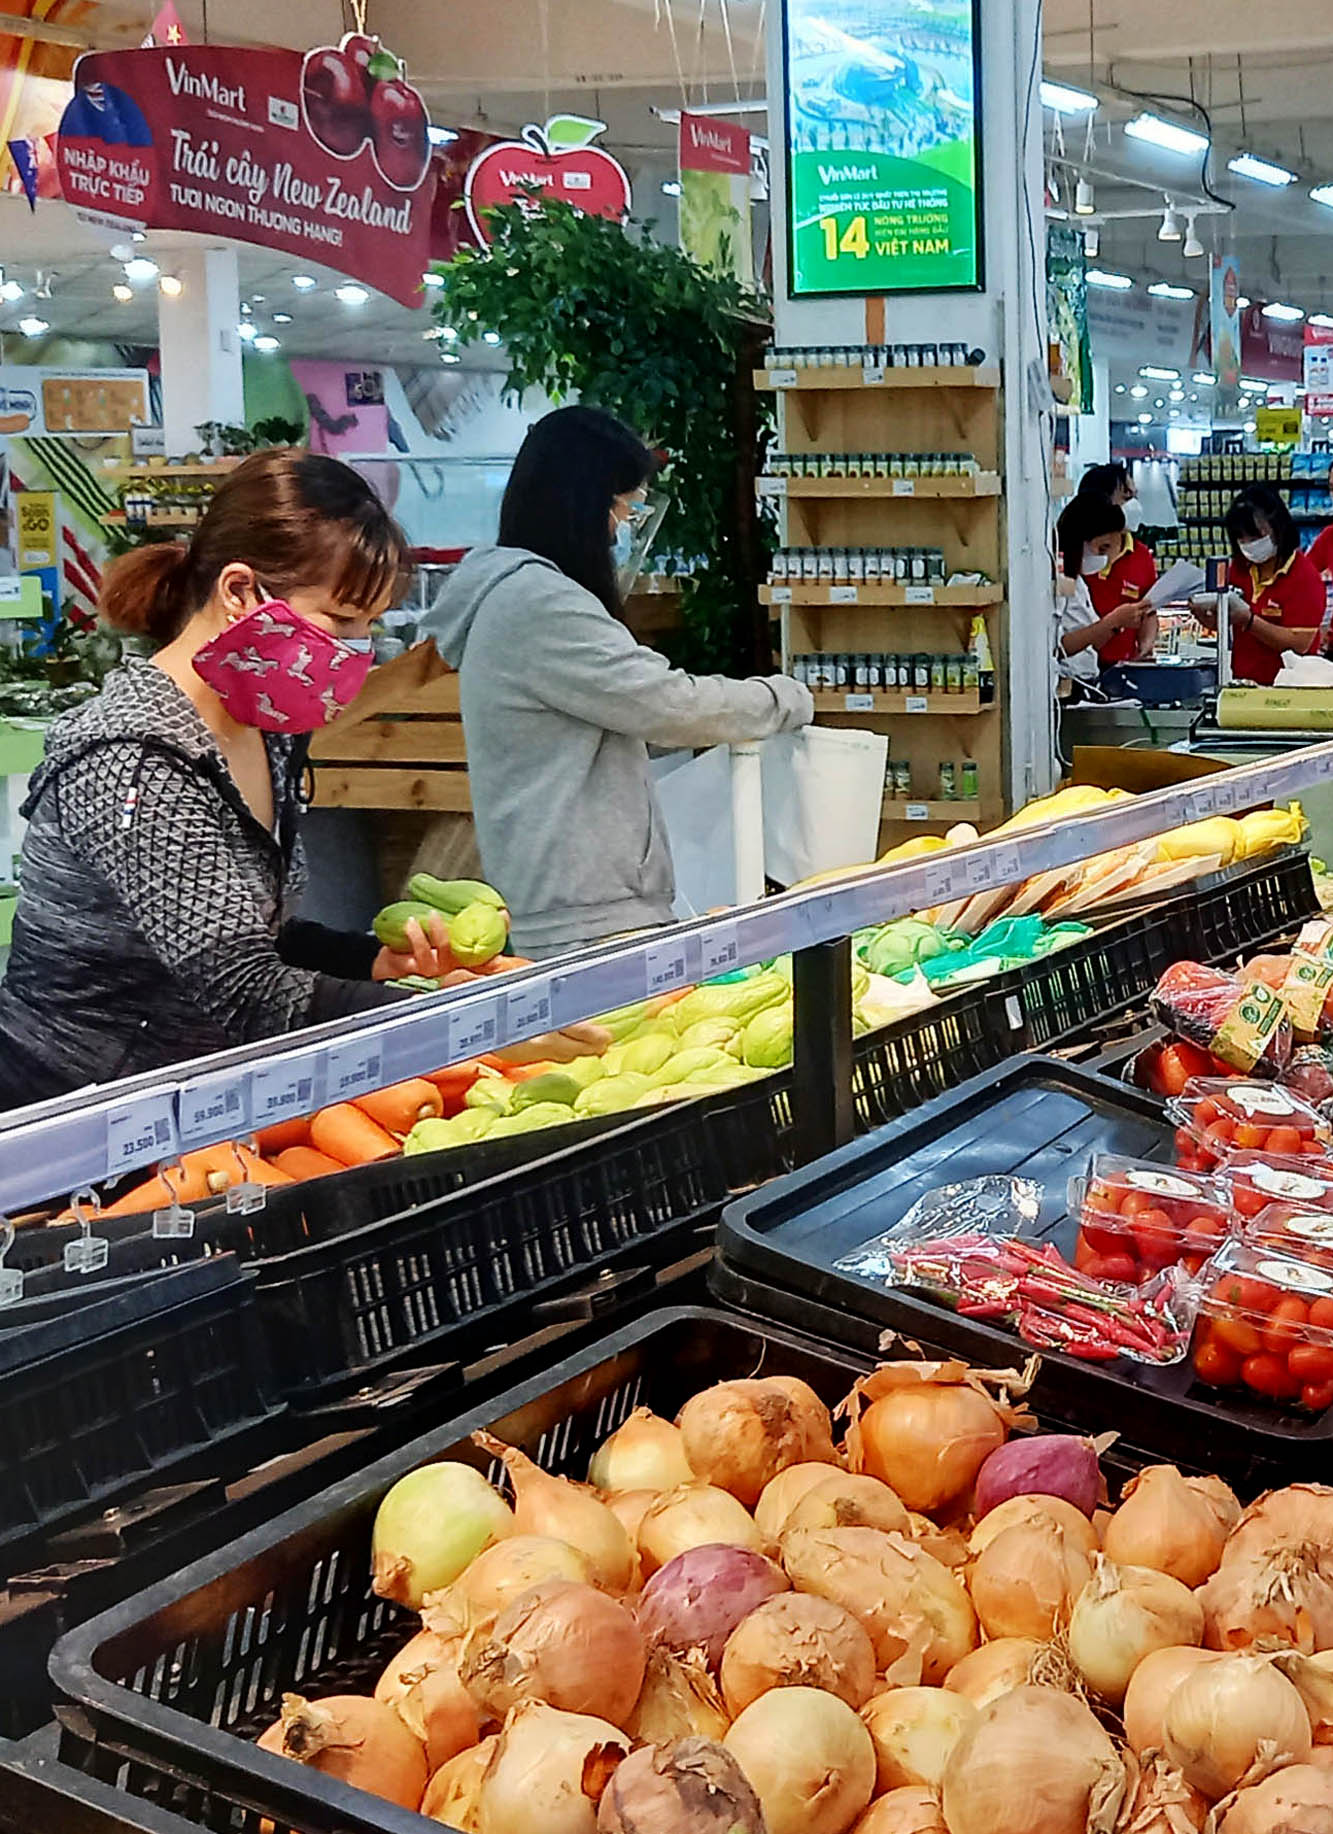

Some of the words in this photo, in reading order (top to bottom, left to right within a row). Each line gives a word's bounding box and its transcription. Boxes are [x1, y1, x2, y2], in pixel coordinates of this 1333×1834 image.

[166, 57, 246, 112] VinMart
[170, 129, 219, 181] Trái
[226, 151, 269, 204] cây
[273, 163, 322, 209] New
[323, 177, 413, 234] Zealand
[818, 165, 878, 186] VinMart
[205, 193, 246, 221] NGON
[819, 216, 870, 260] 14
[875, 237, 908, 257] VIỆT
[912, 238, 949, 254] NAM
